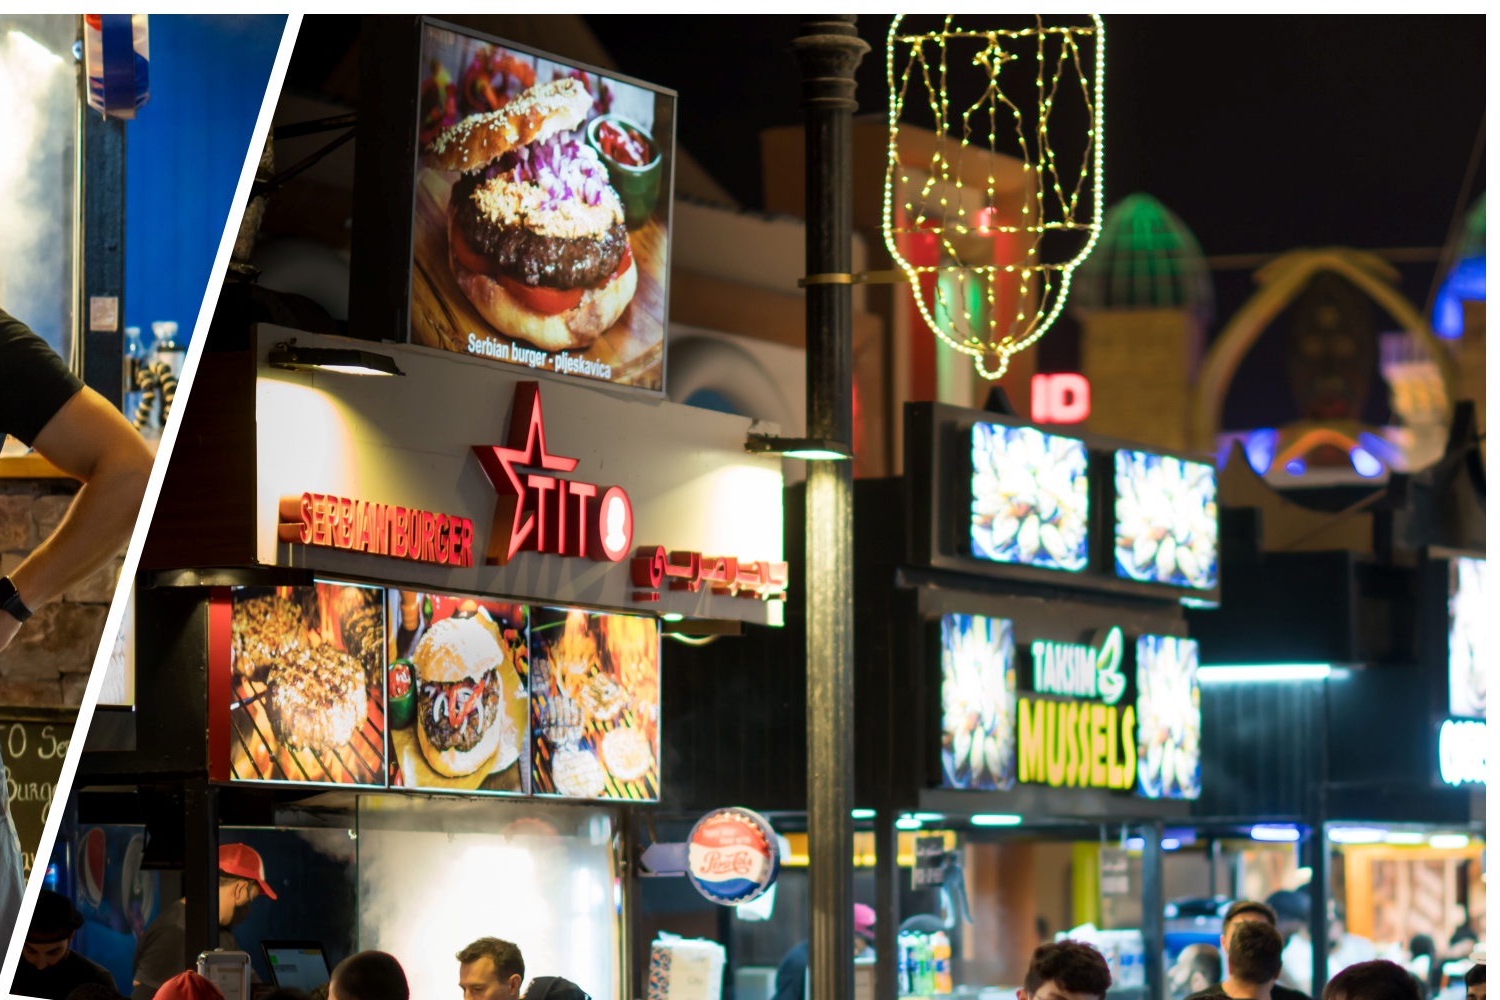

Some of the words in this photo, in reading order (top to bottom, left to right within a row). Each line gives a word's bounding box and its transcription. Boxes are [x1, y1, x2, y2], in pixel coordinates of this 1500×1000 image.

[467, 332, 510, 360] Serbian
[511, 341, 547, 368] burger
[554, 354, 612, 379] pljeskavica
[299, 492, 390, 556] SERBIAN
[391, 506, 475, 568] BURGER
[527, 475, 633, 562] TITO
[1031, 640, 1097, 698] TAKSIM
[1018, 698, 1137, 789] MUSSELS
